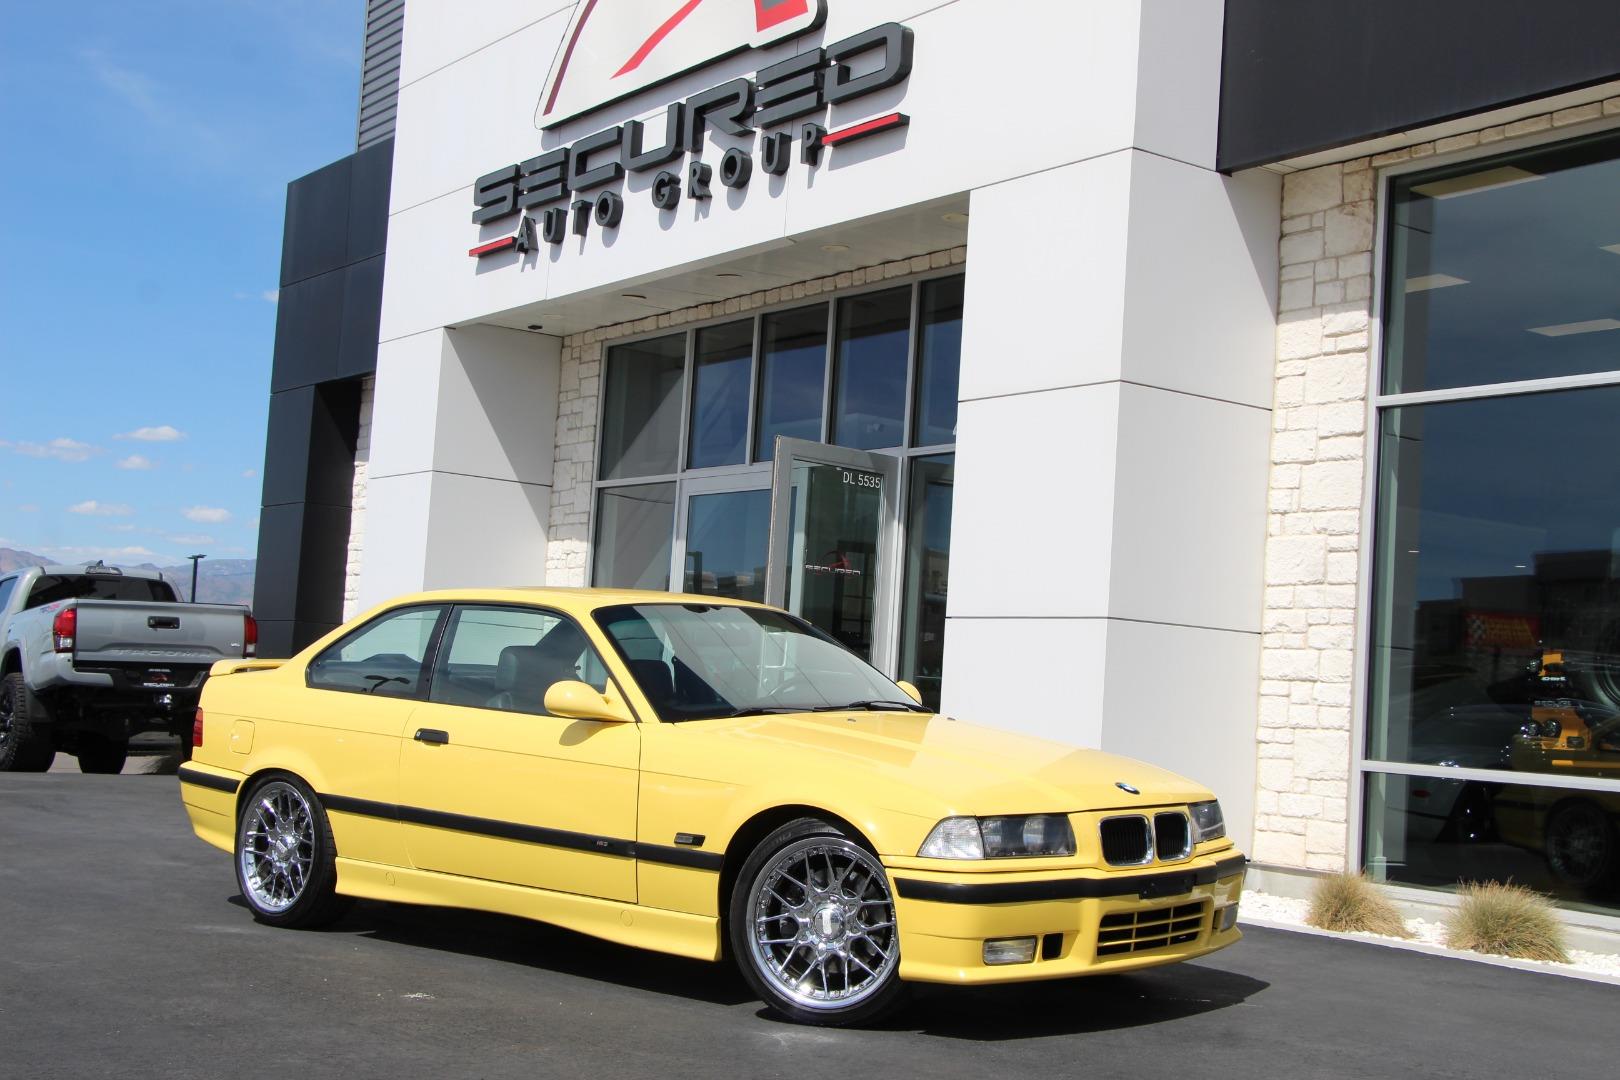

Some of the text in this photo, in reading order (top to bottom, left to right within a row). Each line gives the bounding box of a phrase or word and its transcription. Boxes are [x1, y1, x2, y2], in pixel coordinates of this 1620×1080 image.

[472, 21, 915, 225] SECURED
[515, 122, 827, 254] AUTO GROUP
[843, 471, 880, 488] DL 5535
